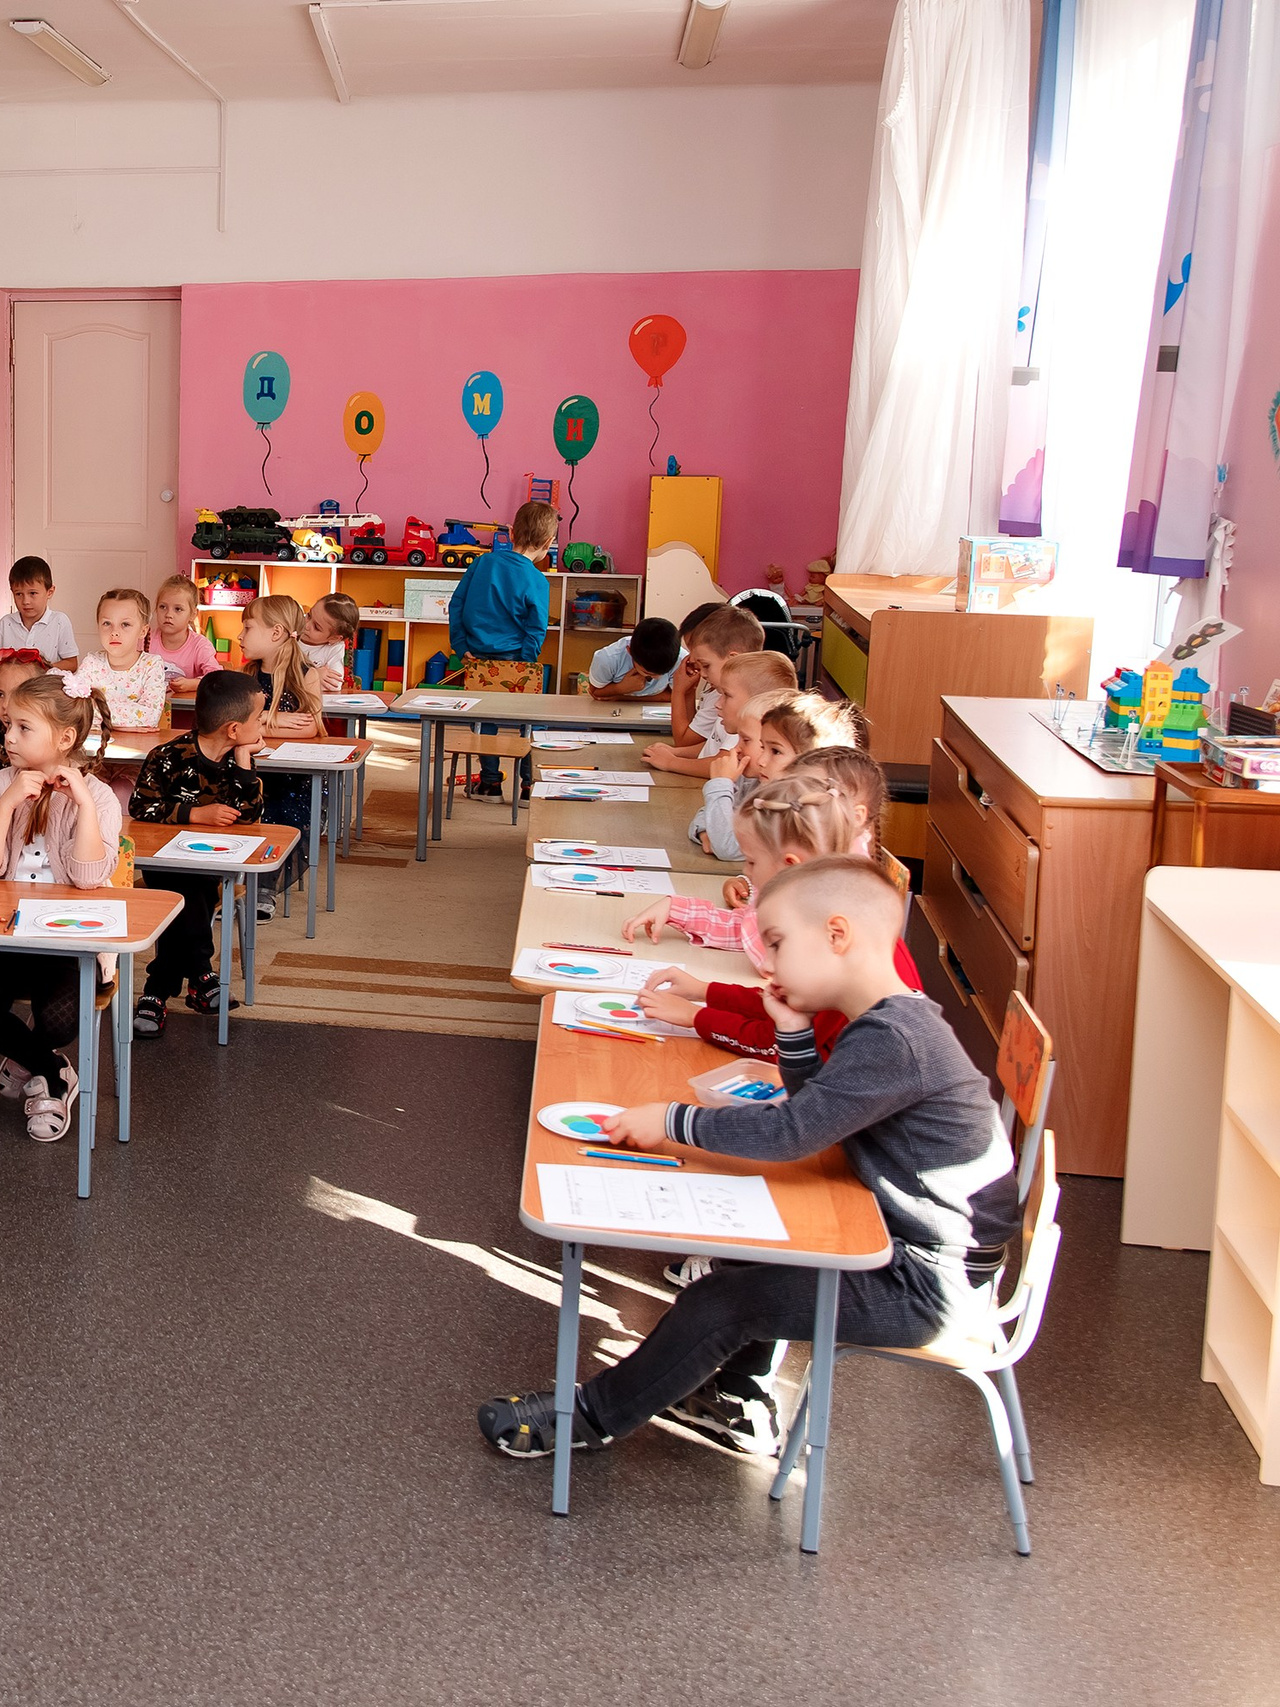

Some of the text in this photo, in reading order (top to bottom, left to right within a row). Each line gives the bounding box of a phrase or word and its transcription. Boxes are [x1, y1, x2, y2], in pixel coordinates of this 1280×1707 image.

[256, 376, 276, 400] Д
[473, 393, 491, 415] М
[355, 410, 374, 435] О
[566, 418, 585, 441] И
[568, 1242, 576, 1259] 1
